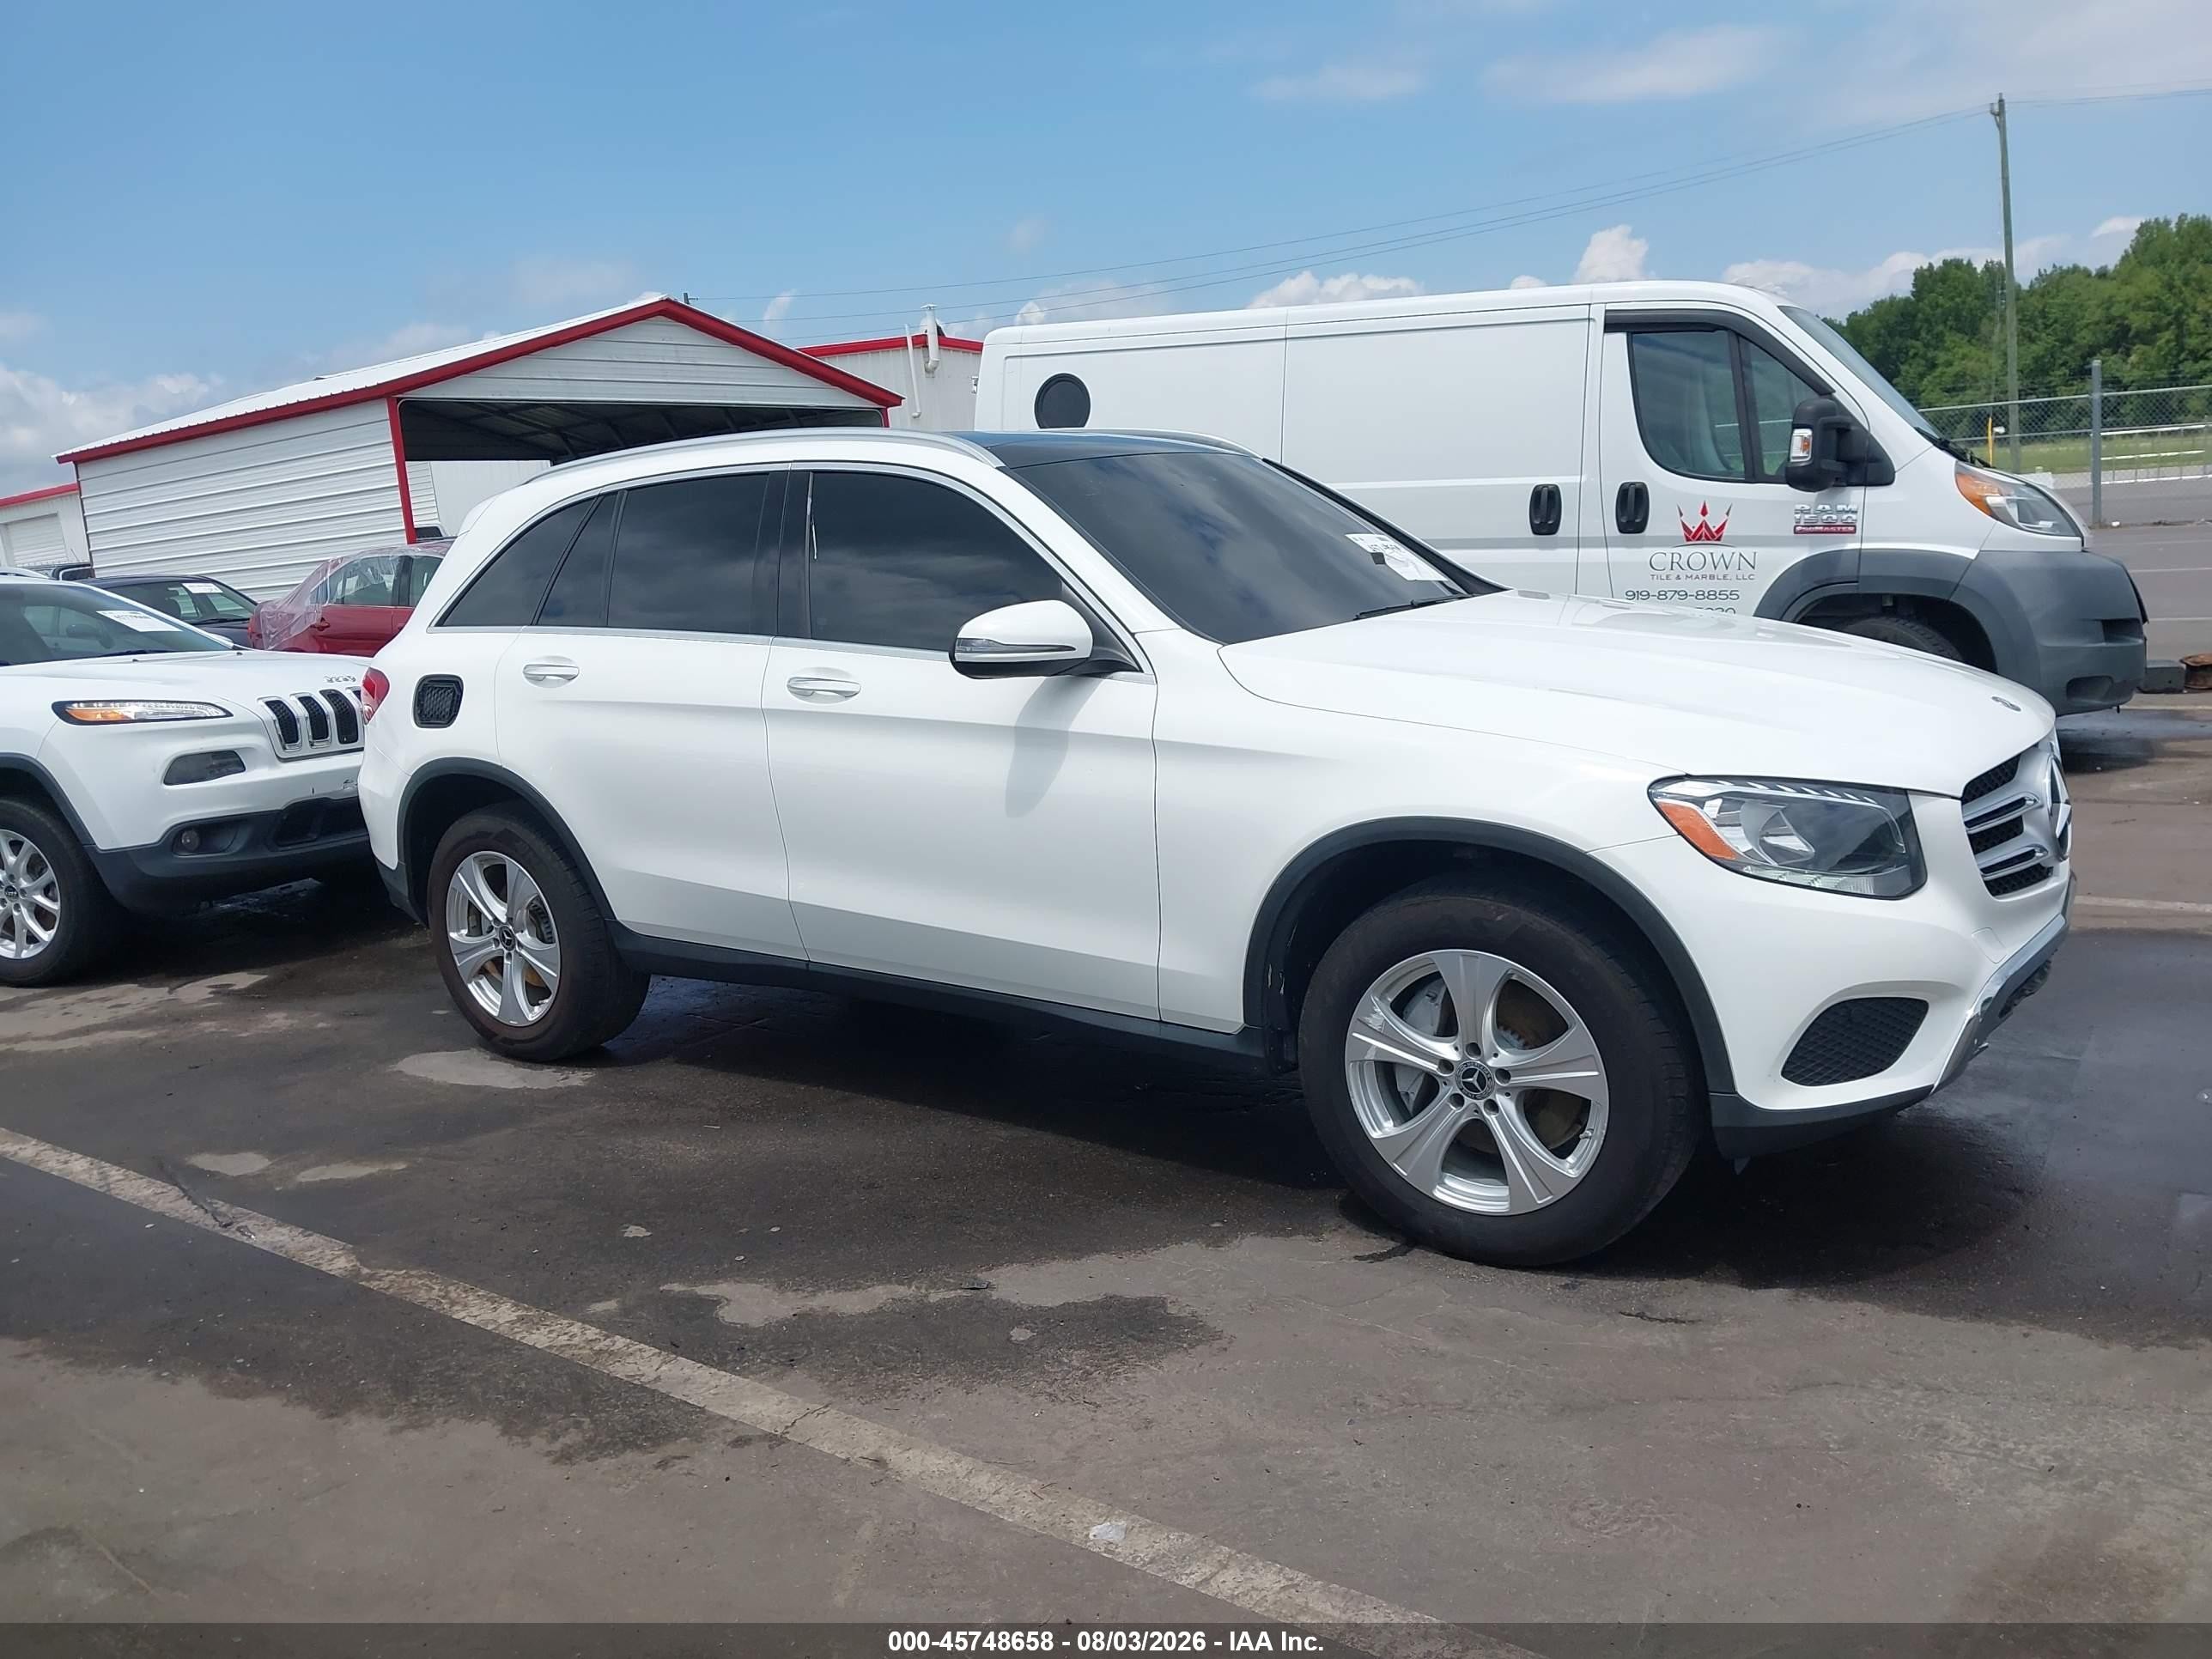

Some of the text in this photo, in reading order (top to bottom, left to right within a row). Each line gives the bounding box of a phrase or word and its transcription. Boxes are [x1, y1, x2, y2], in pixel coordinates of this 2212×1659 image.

[1794, 504, 1858, 514] RAM
[1794, 514, 1857, 524] 1500
[1650, 551, 1758, 571] CROWN
[1625, 589, 1740, 601] 919-879-8855
